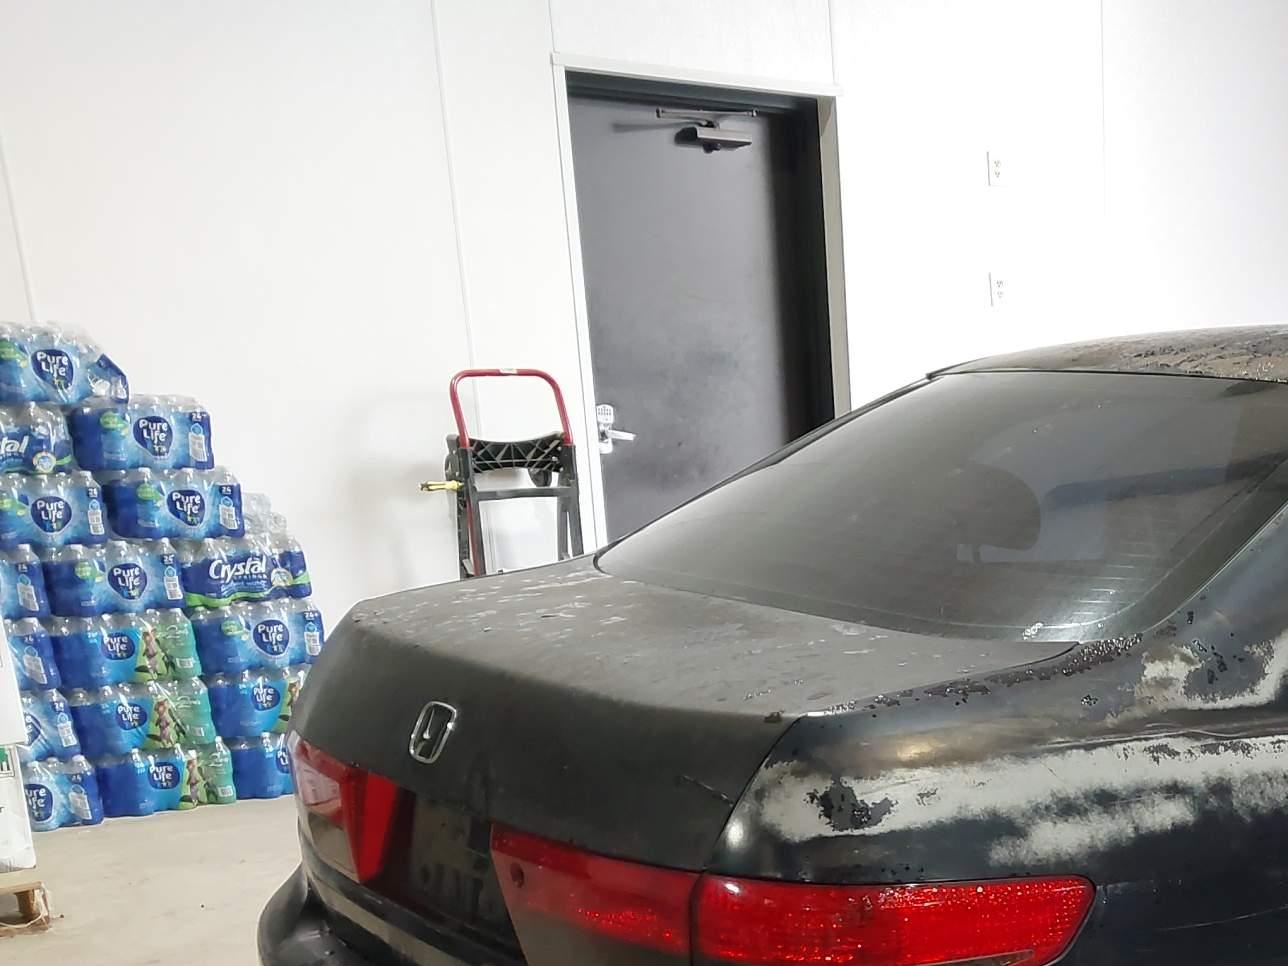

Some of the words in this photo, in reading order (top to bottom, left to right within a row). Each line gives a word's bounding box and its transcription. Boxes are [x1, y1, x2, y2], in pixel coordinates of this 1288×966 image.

[37, 352, 68, 365] Pure
[42, 362, 66, 380] Life
[139, 419, 168, 431] Pure
[143, 430, 166, 444] Life
[172, 492, 201, 503] Pure
[37, 501, 64, 511] Pure
[176, 501, 199, 514] Life
[41, 510, 63, 526] Life
[113, 567, 140, 577] Pure
[208, 555, 267, 583] Crystal
[118, 577, 140, 590] Life
[258, 624, 284, 633] Pure
[103, 636, 128, 644] Pure
[262, 633, 283, 644] Life
[107, 644, 127, 653] Life
[253, 687, 274, 696] Pure
[256, 694, 273, 704] Life
[117, 705, 140, 713] Pure
[122, 713, 139, 722] Life
[150, 765, 173, 773] Pure
[153, 772, 172, 782] Life
[25, 788, 46, 797] ure
[28, 797, 45, 809] ife
